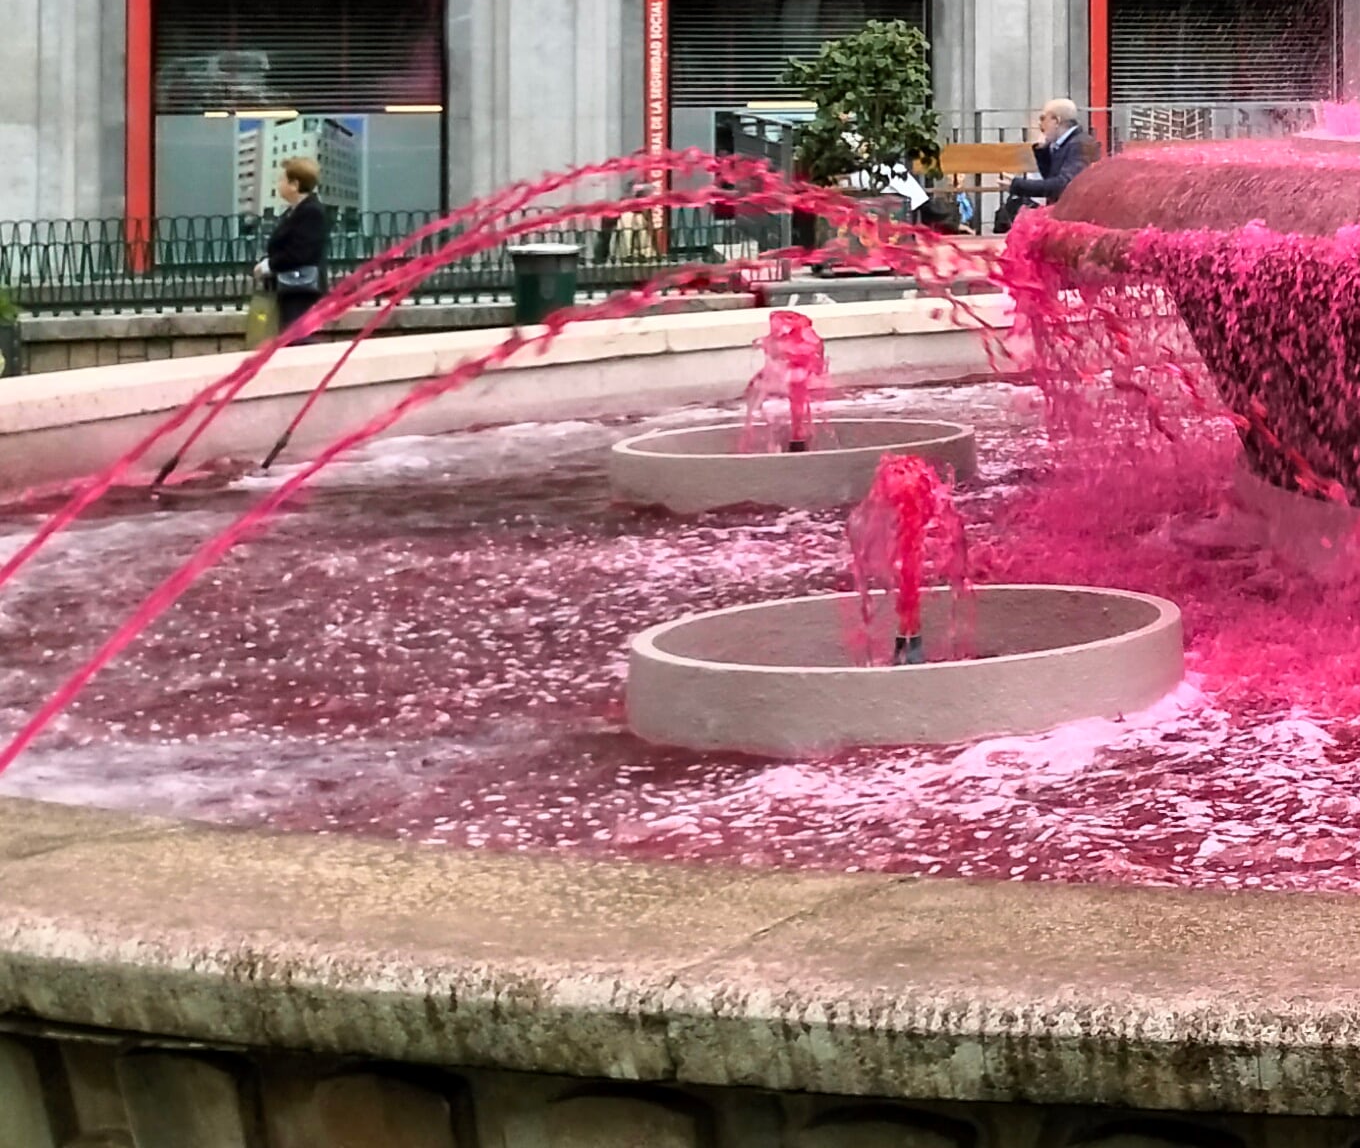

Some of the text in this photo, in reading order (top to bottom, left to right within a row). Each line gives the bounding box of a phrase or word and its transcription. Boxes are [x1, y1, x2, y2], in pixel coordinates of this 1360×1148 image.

[649, 1, 663, 39] SOCIAL
[649, 40, 662, 99] SEGURIDAD
[649, 100, 662, 115] LA
